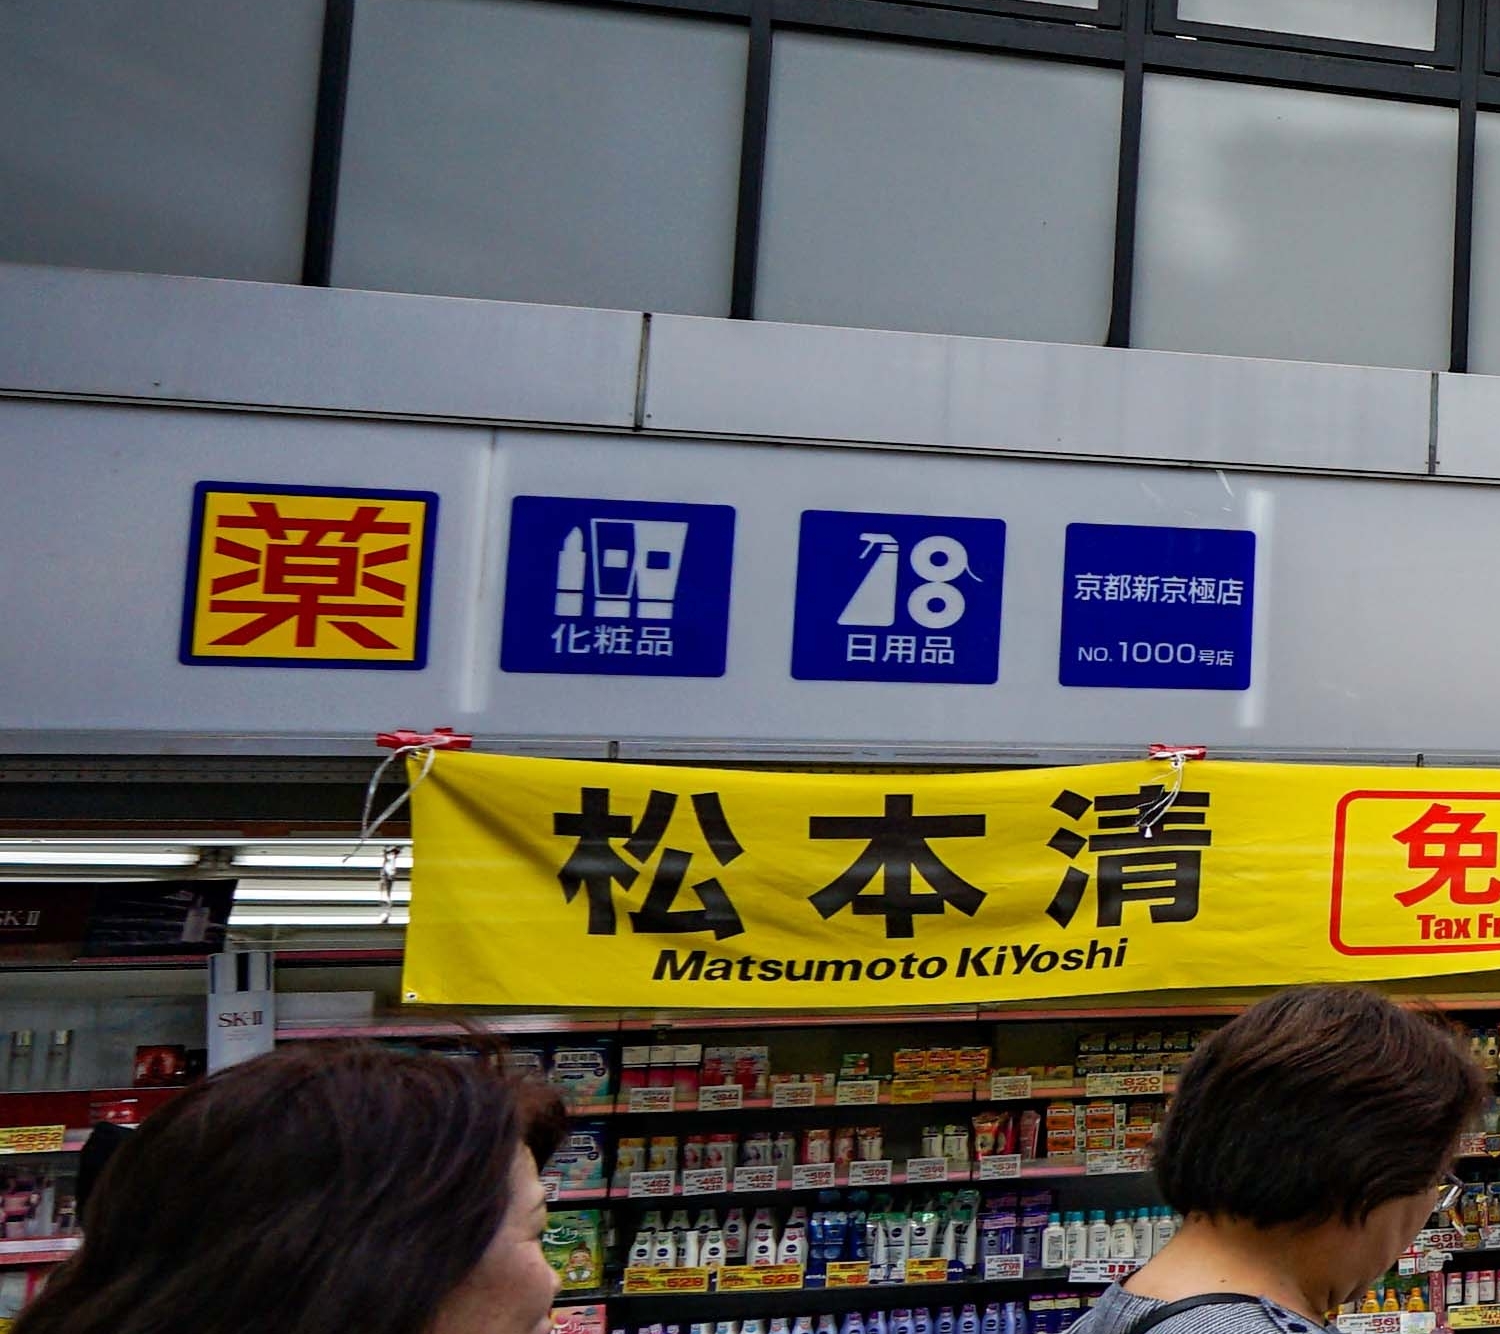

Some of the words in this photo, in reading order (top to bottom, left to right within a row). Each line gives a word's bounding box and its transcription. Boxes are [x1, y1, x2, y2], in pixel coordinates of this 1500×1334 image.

[209, 501, 409, 651] 薬
[1073, 572, 1244, 607] 京都新京極店
[551, 622, 674, 658] 化粧品
[847, 633, 956, 666] 日用品
[1078, 645, 1113, 663] NO.
[1117, 640, 1235, 669] 1000号店
[553, 784, 1213, 941] 松本清
[1418, 913, 1472, 941] Tax
[652, 948, 945, 983] Matsumoto
[959, 936, 1128, 979] KiYoshi
[218, 1010, 263, 1028] SK-II
[667, 1276, 705, 1289] 528
[761, 1272, 801, 1285] 528
